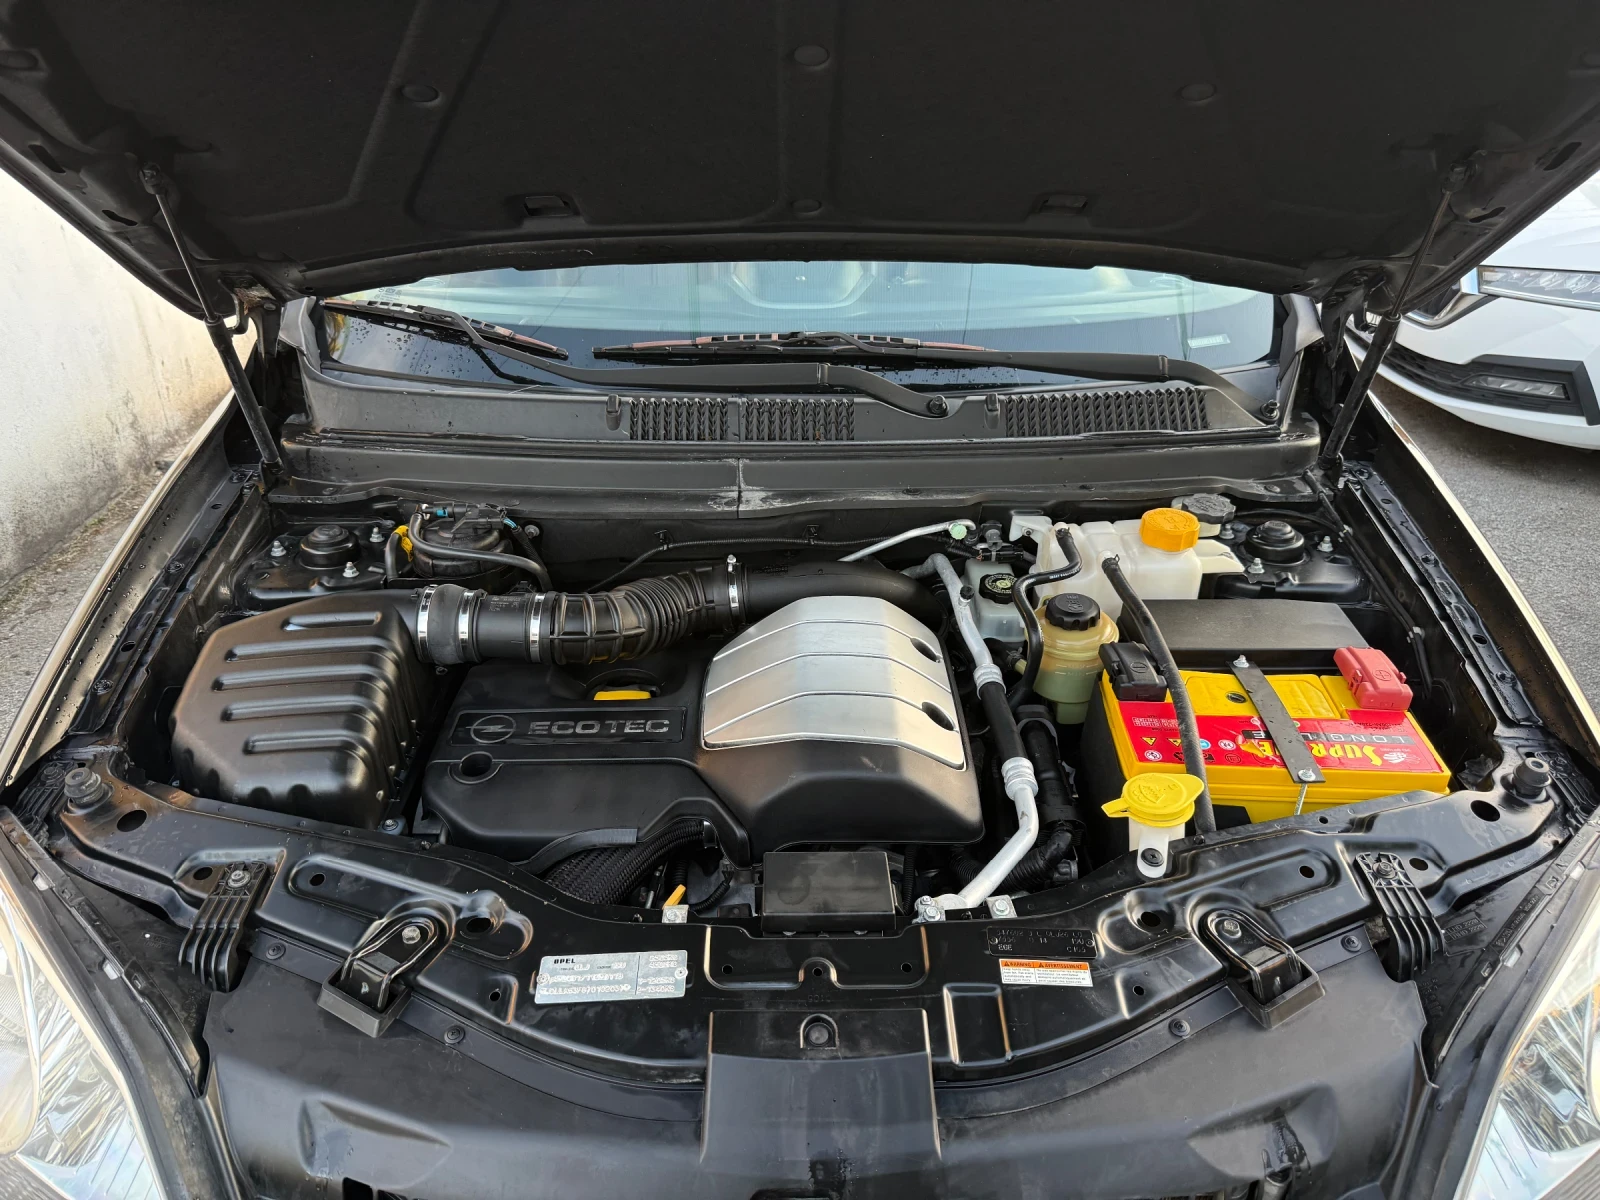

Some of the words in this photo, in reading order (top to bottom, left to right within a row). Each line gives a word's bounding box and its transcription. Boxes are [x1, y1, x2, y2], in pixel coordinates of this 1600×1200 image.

[528, 719, 670, 735] ECOTEC
[1251, 730, 1314, 741] LE
[1330, 732, 1405, 744] LONG
[1257, 741, 1383, 767] SUPRE
